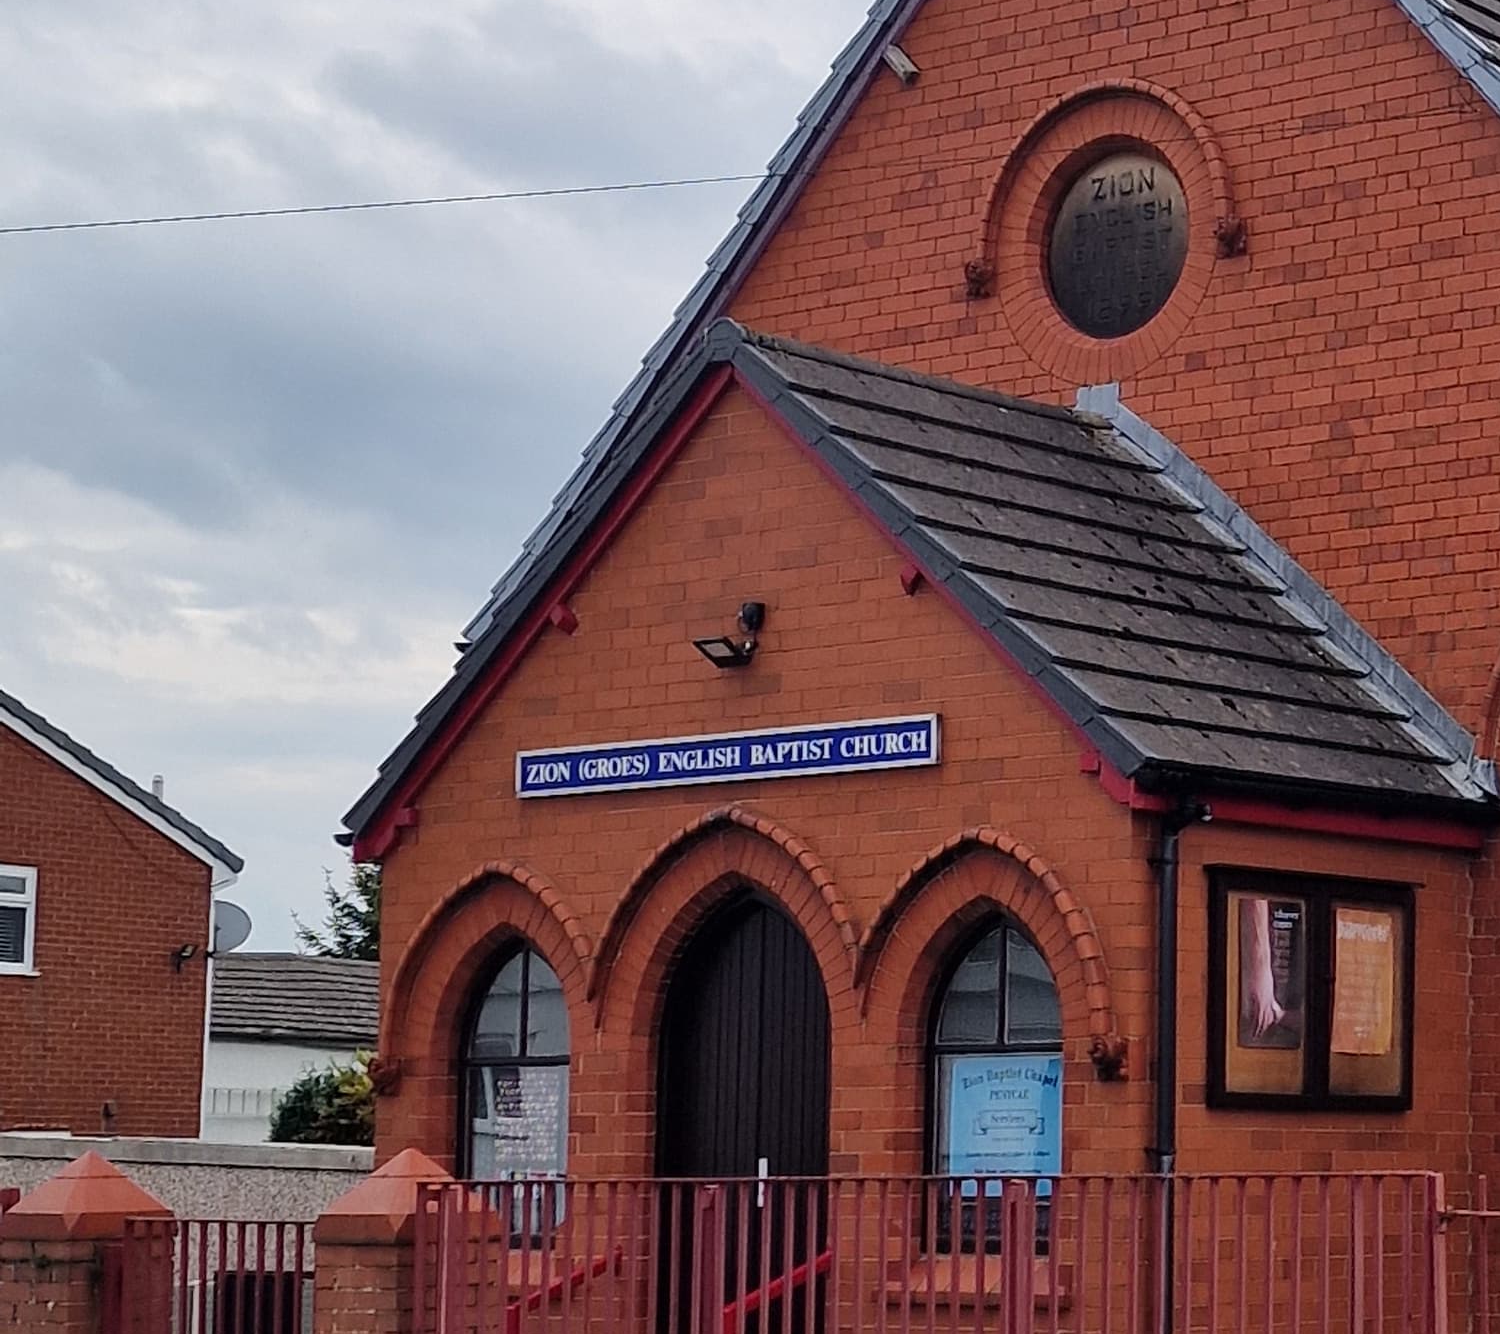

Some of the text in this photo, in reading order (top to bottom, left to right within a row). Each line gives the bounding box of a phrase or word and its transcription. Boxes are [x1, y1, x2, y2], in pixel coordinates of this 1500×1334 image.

[1091, 167, 1155, 201] ZION
[527, 729, 928, 784] ZION (GROES) ENGLISH BAPTIST CHURCH
